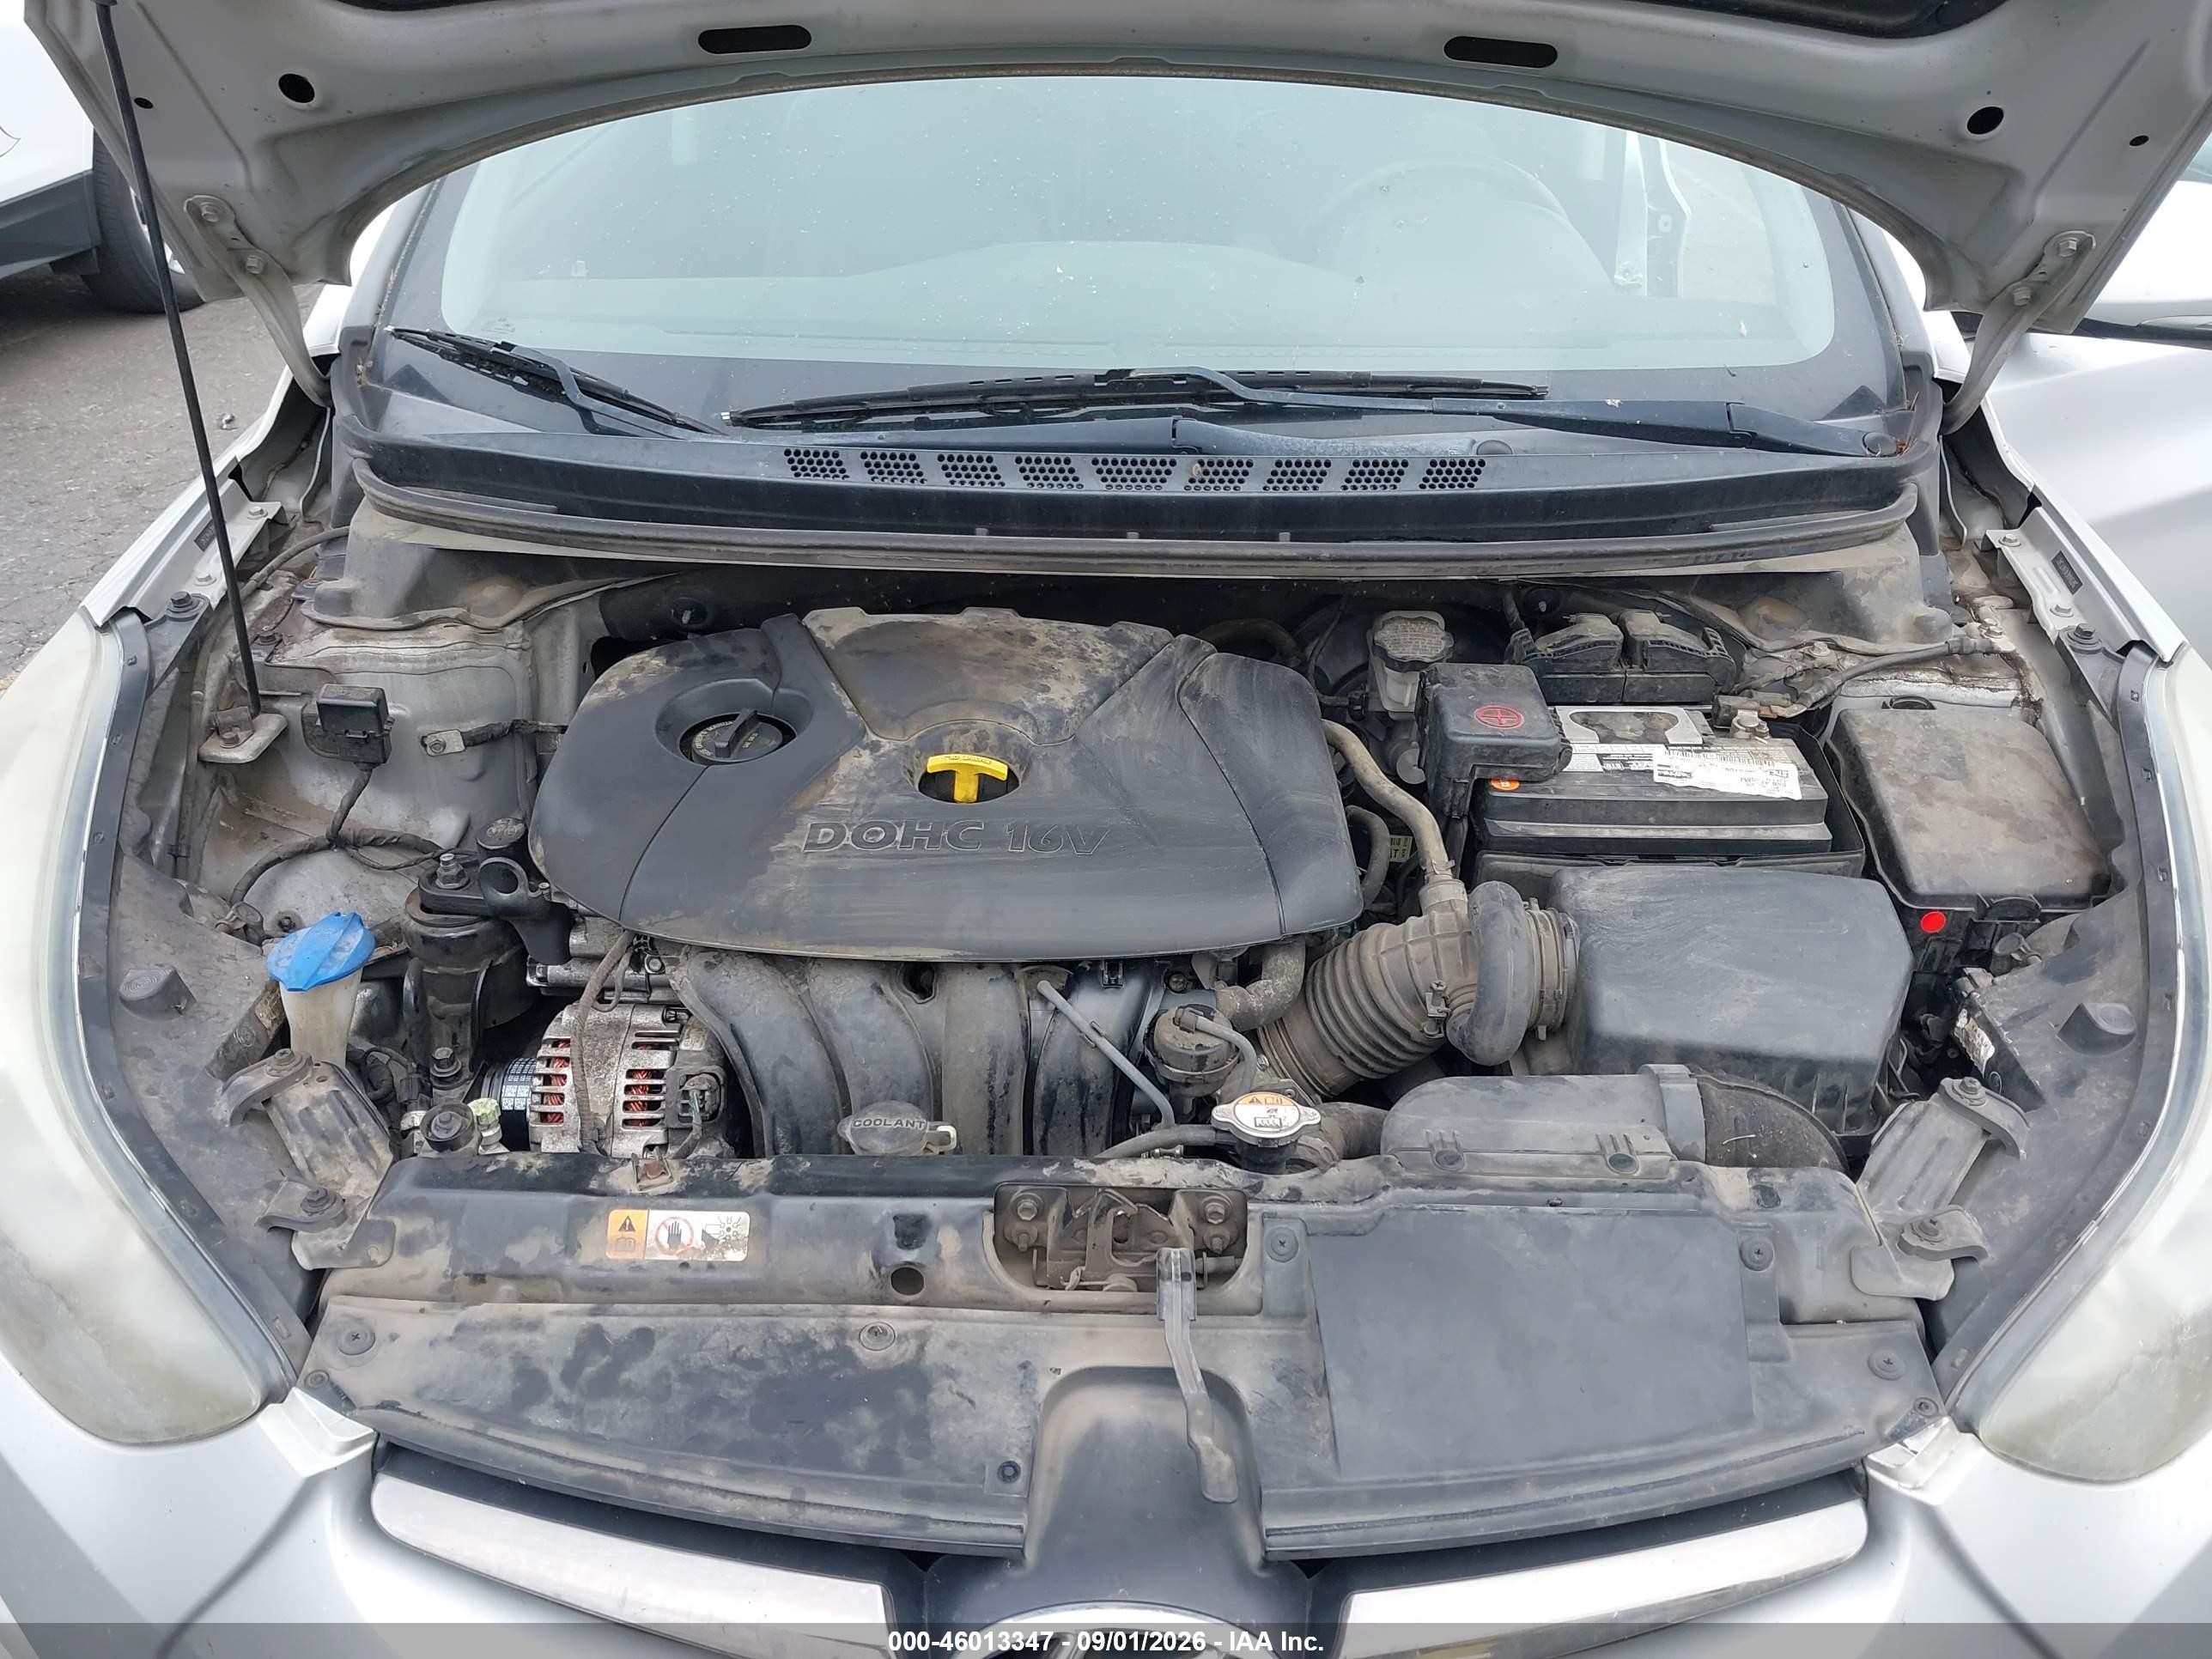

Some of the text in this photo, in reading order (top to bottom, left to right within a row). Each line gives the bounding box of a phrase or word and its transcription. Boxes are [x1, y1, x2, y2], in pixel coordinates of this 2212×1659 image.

[802, 818, 1110, 855] DOHC 16V
[853, 1118, 926, 1129] COOLANT
